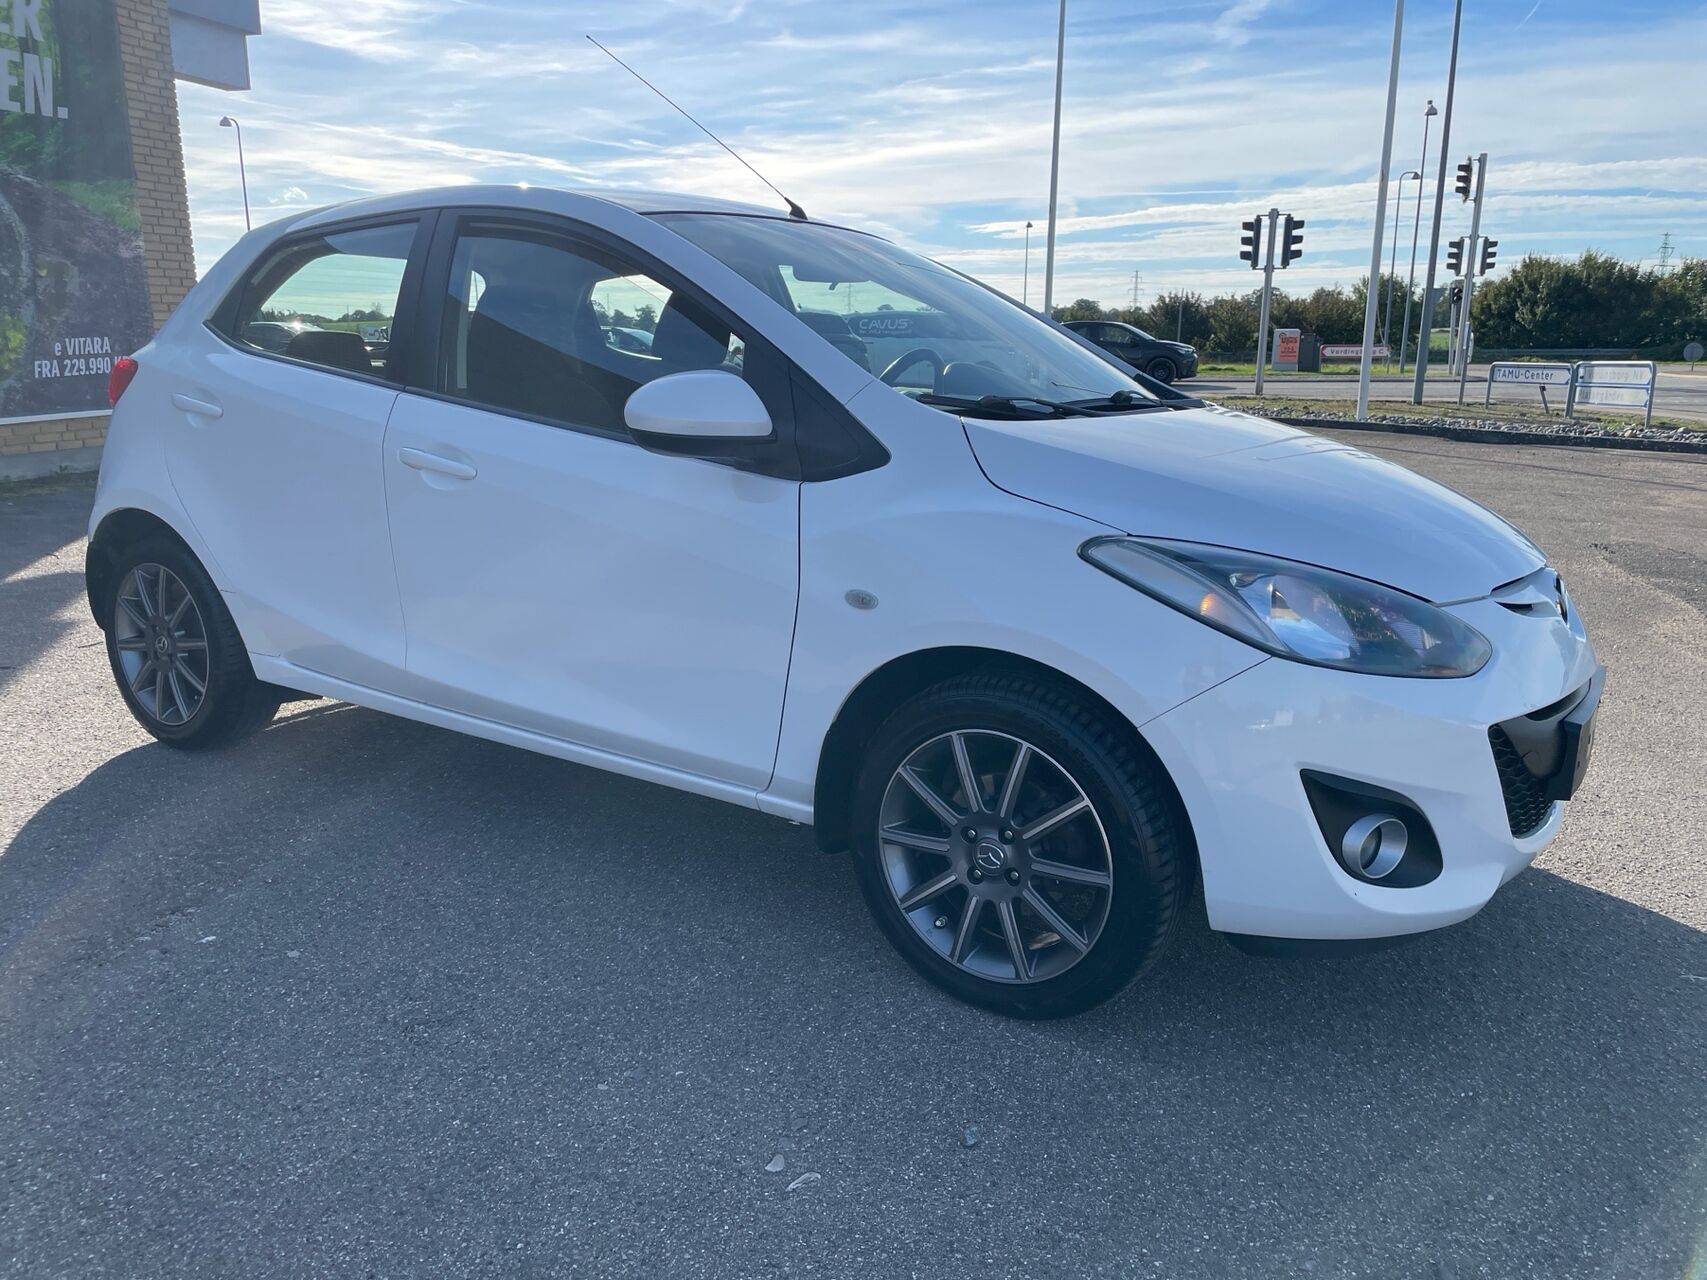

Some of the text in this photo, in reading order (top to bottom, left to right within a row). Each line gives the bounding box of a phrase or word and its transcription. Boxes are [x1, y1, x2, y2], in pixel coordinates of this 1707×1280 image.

[0, 48, 68, 119] EN.
[859, 319, 908, 329] CAVUS
[54, 337, 111, 356] e VITARA
[34, 360, 60, 378] FRA
[64, 357, 111, 376] 229.990
[1497, 369, 1554, 380] TAMU-Center
